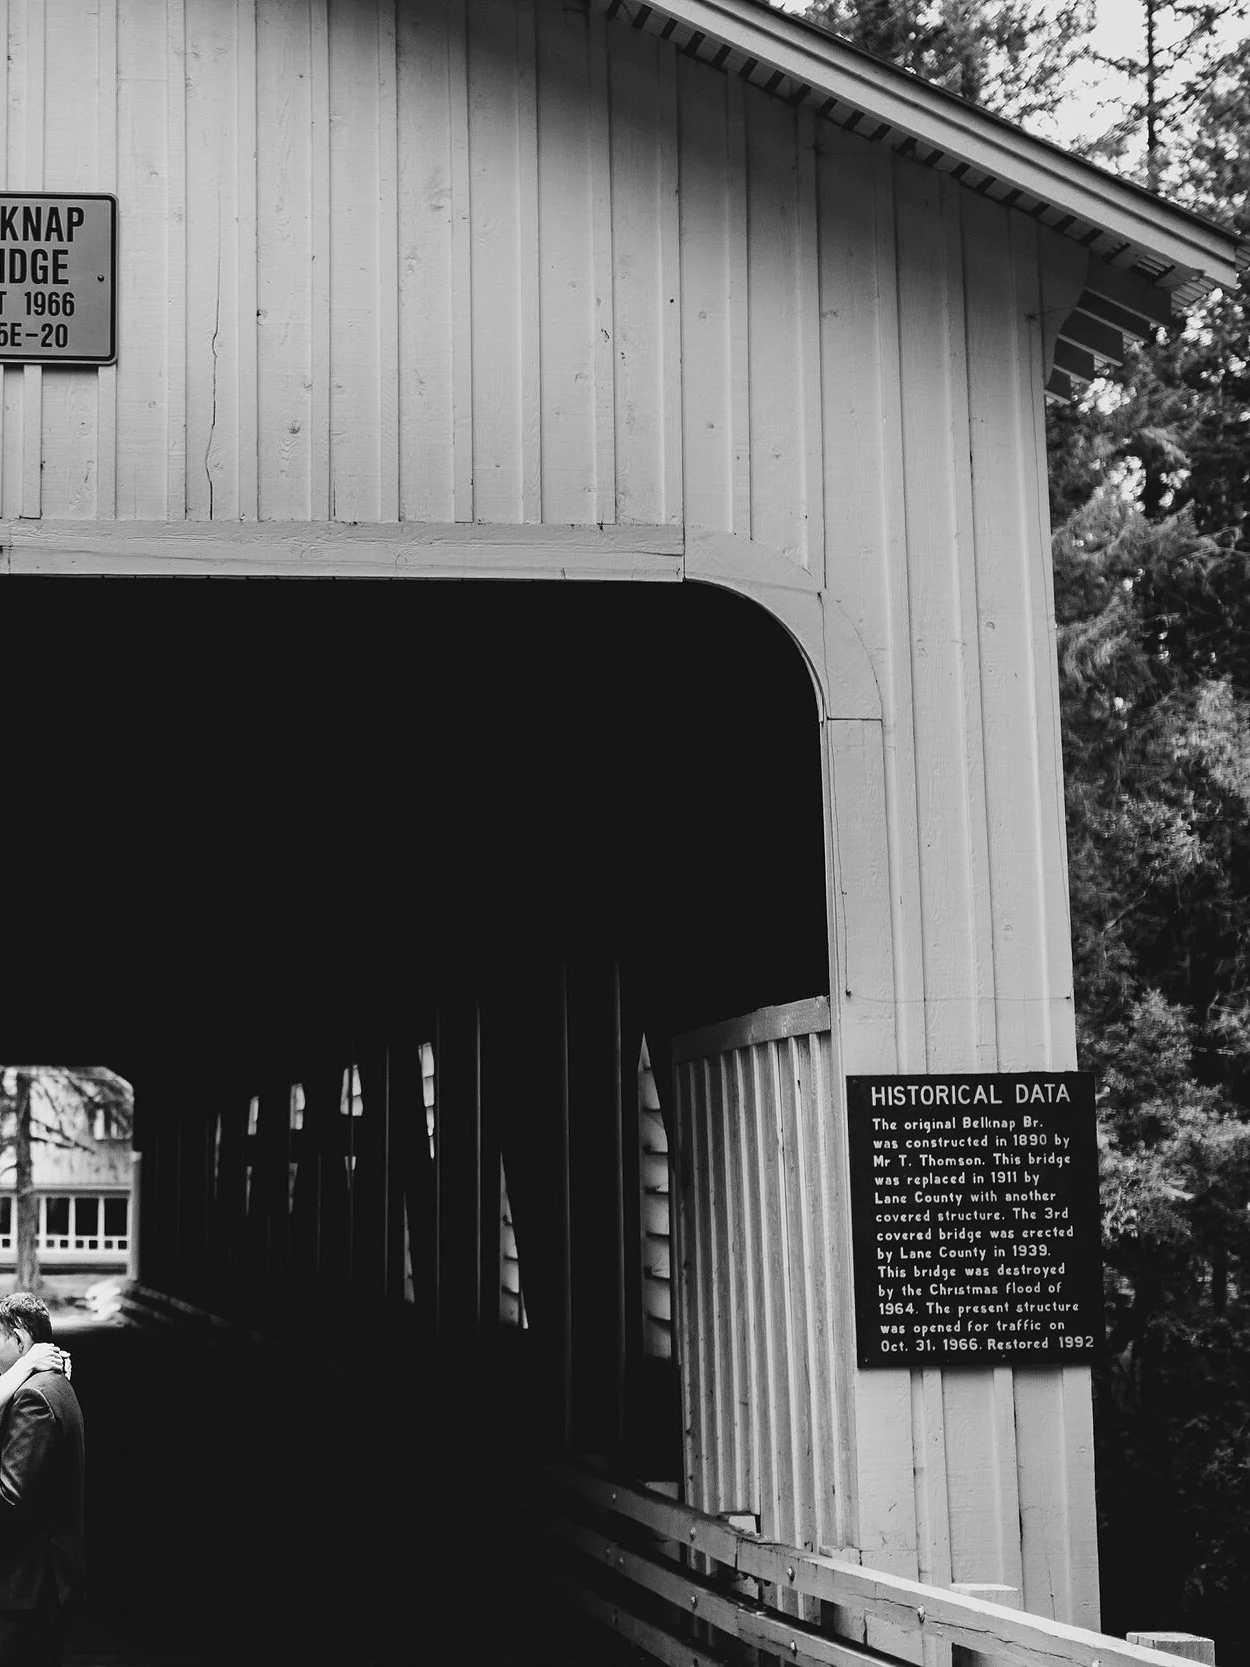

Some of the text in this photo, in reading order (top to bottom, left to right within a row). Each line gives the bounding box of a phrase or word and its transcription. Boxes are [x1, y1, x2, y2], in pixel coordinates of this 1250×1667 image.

[25, 292, 74, 316] 1966
[872, 1084, 1070, 1106] HISTORICAL DATA
[872, 1116, 1043, 1133] The original Belknap Br.
[873, 1134, 1069, 1149] was constructed in 1890 by
[874, 1152, 1070, 1168] Mr T. Thomson. This bridge
[875, 1171, 1039, 1188] was replaced in 1911 by
[875, 1190, 1056, 1206] Lane County with another
[876, 1207, 1068, 1222] covered structure. The 3rd
[877, 1225, 1073, 1243] covered bridge was erected
[878, 1244, 1050, 1263] by Lane County in 1939.
[878, 1262, 1064, 1280] This bridge was destroyed
[879, 1282, 1061, 1300] by the Christmas flood of
[879, 1302, 1078, 1317] 1964. The present structure
[880, 1325, 905, 1334] was
[914, 1320, 960, 1337] opened
[968, 1321, 988, 1331] for
[997, 1319, 1041, 1331] traffic
[881, 1340, 908, 1352] Oct.
[943, 1338, 982, 1350] 1966.
[988, 1337, 1048, 1350] Restored
[1059, 1336, 1093, 1348] 1992
